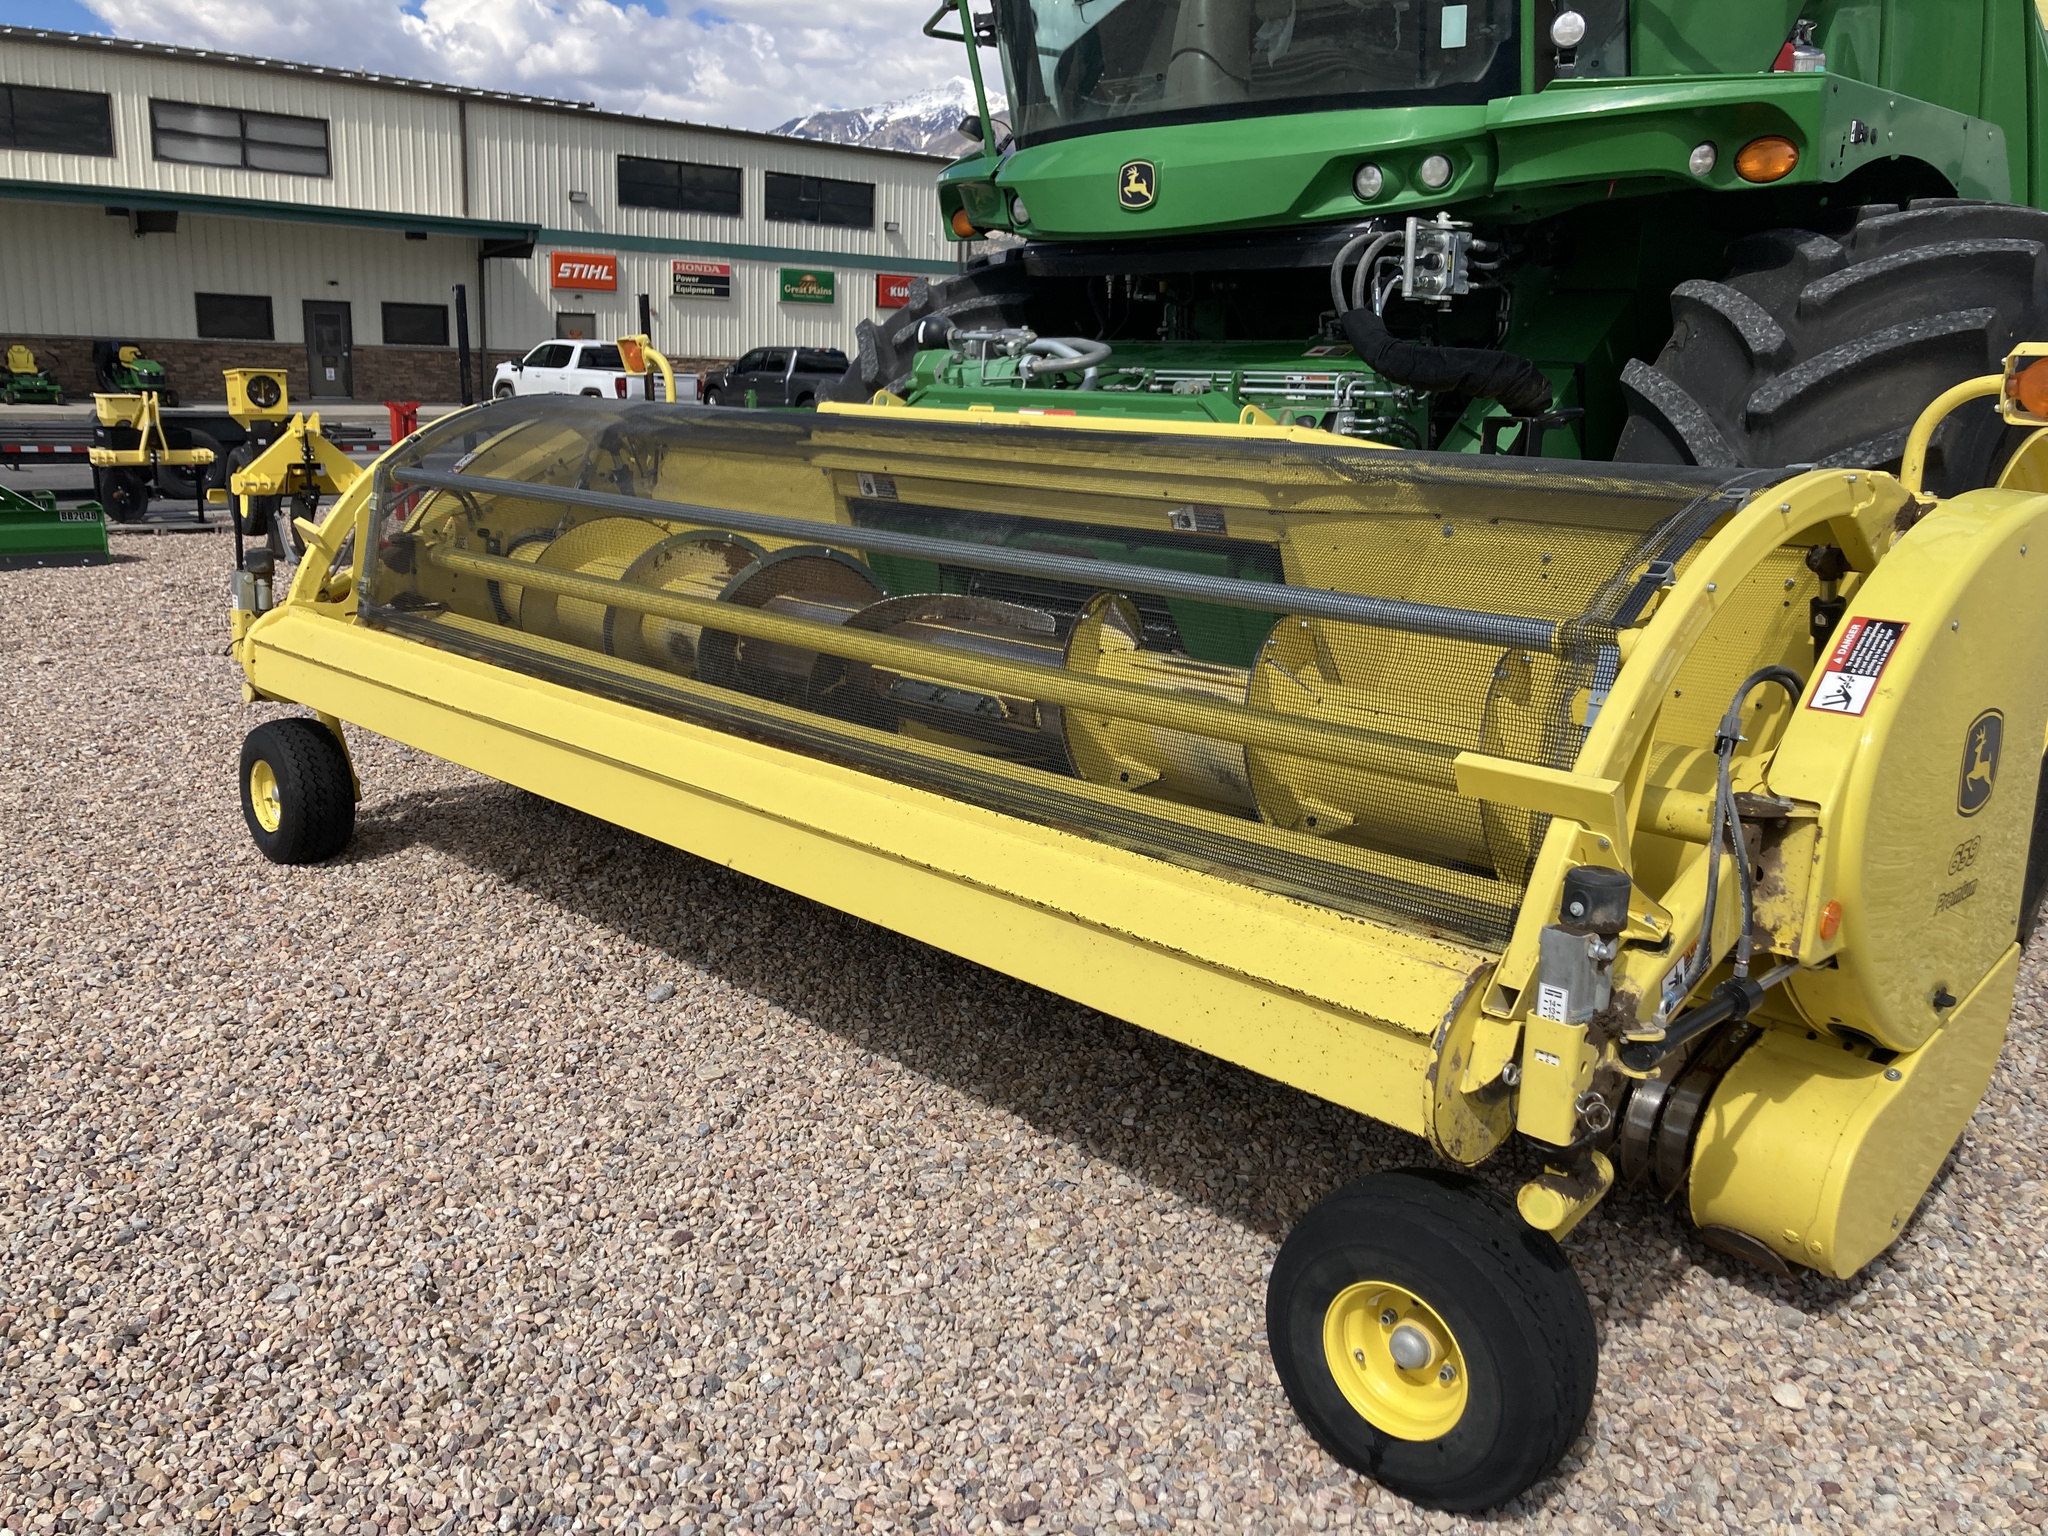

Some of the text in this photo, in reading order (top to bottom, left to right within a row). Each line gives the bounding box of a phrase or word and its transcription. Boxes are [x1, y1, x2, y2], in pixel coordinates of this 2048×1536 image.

[557, 262, 613, 281] STIHL
[675, 263, 721, 274] HONDA
[675, 274, 699, 284] Power
[675, 284, 715, 295] Equipment
[784, 284, 832, 296] Great Plains
[890, 286, 910, 298] KUH
[61, 512, 97, 520] BB2048
[1837, 624, 1861, 655] DANGER
[1948, 835, 1981, 876] 659
[1934, 878, 1979, 916] Premium
[1549, 999, 1556, 1008] 14
[1548, 1007, 1556, 1015] 13
